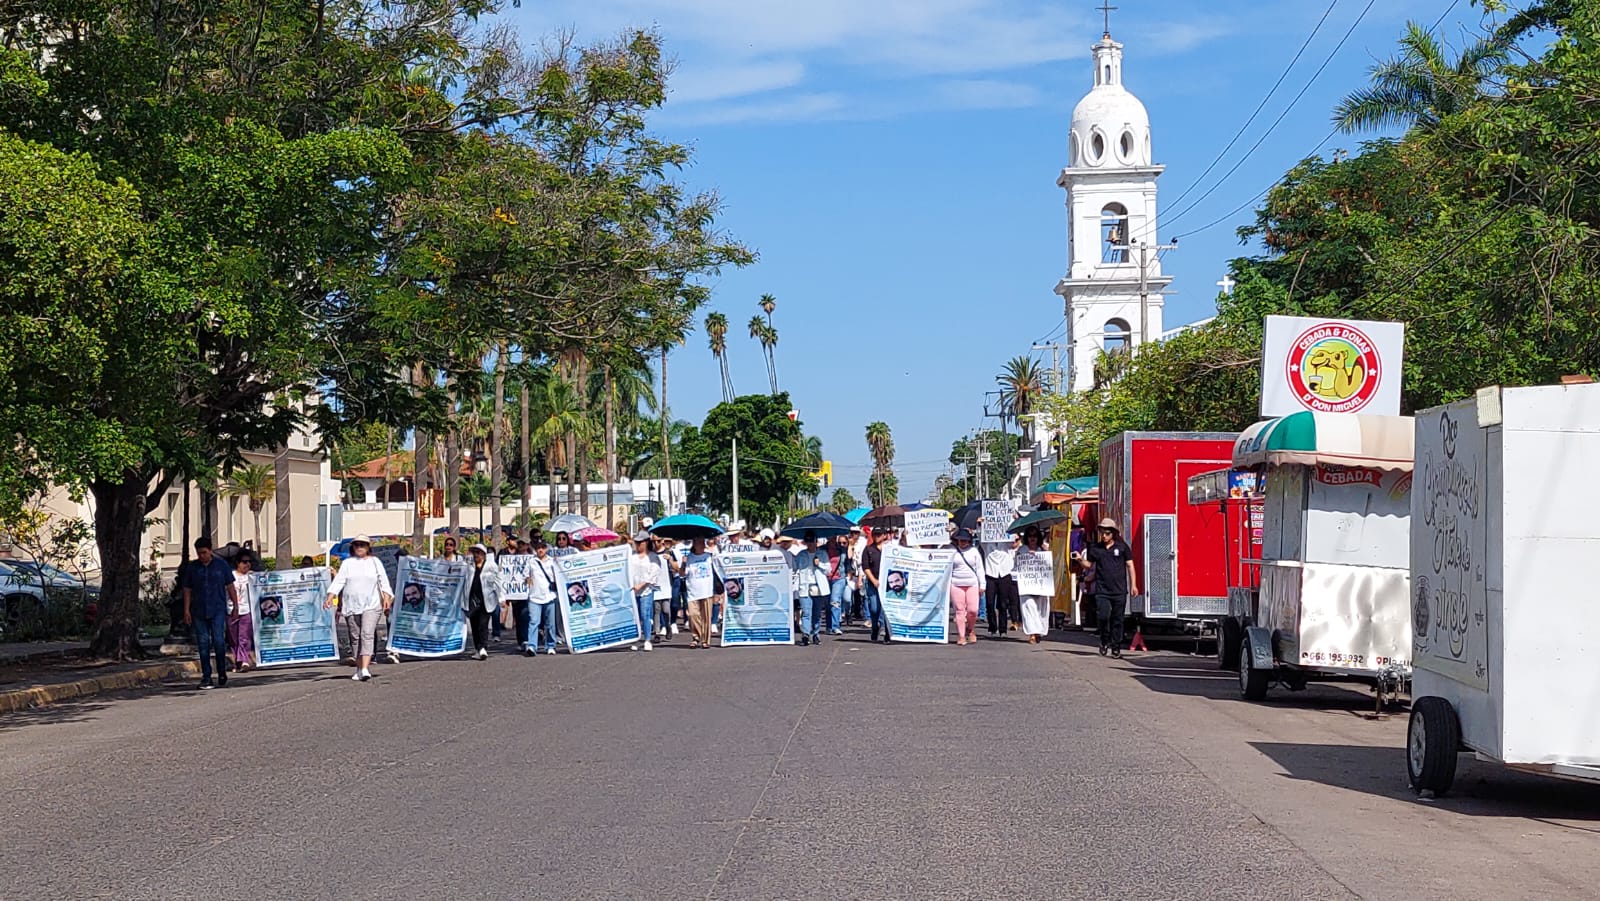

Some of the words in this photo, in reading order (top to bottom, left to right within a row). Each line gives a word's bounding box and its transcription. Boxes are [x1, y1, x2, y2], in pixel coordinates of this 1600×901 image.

[1300, 328, 1332, 350] CEBADA
[1332, 328, 1341, 336] &
[1342, 329, 1371, 353] DONAS
[1312, 400, 1331, 412] DON
[1332, 398, 1364, 412] MIGUEL
[1439, 407, 1458, 459] Rico
[1323, 470, 1373, 483] CEBADA
